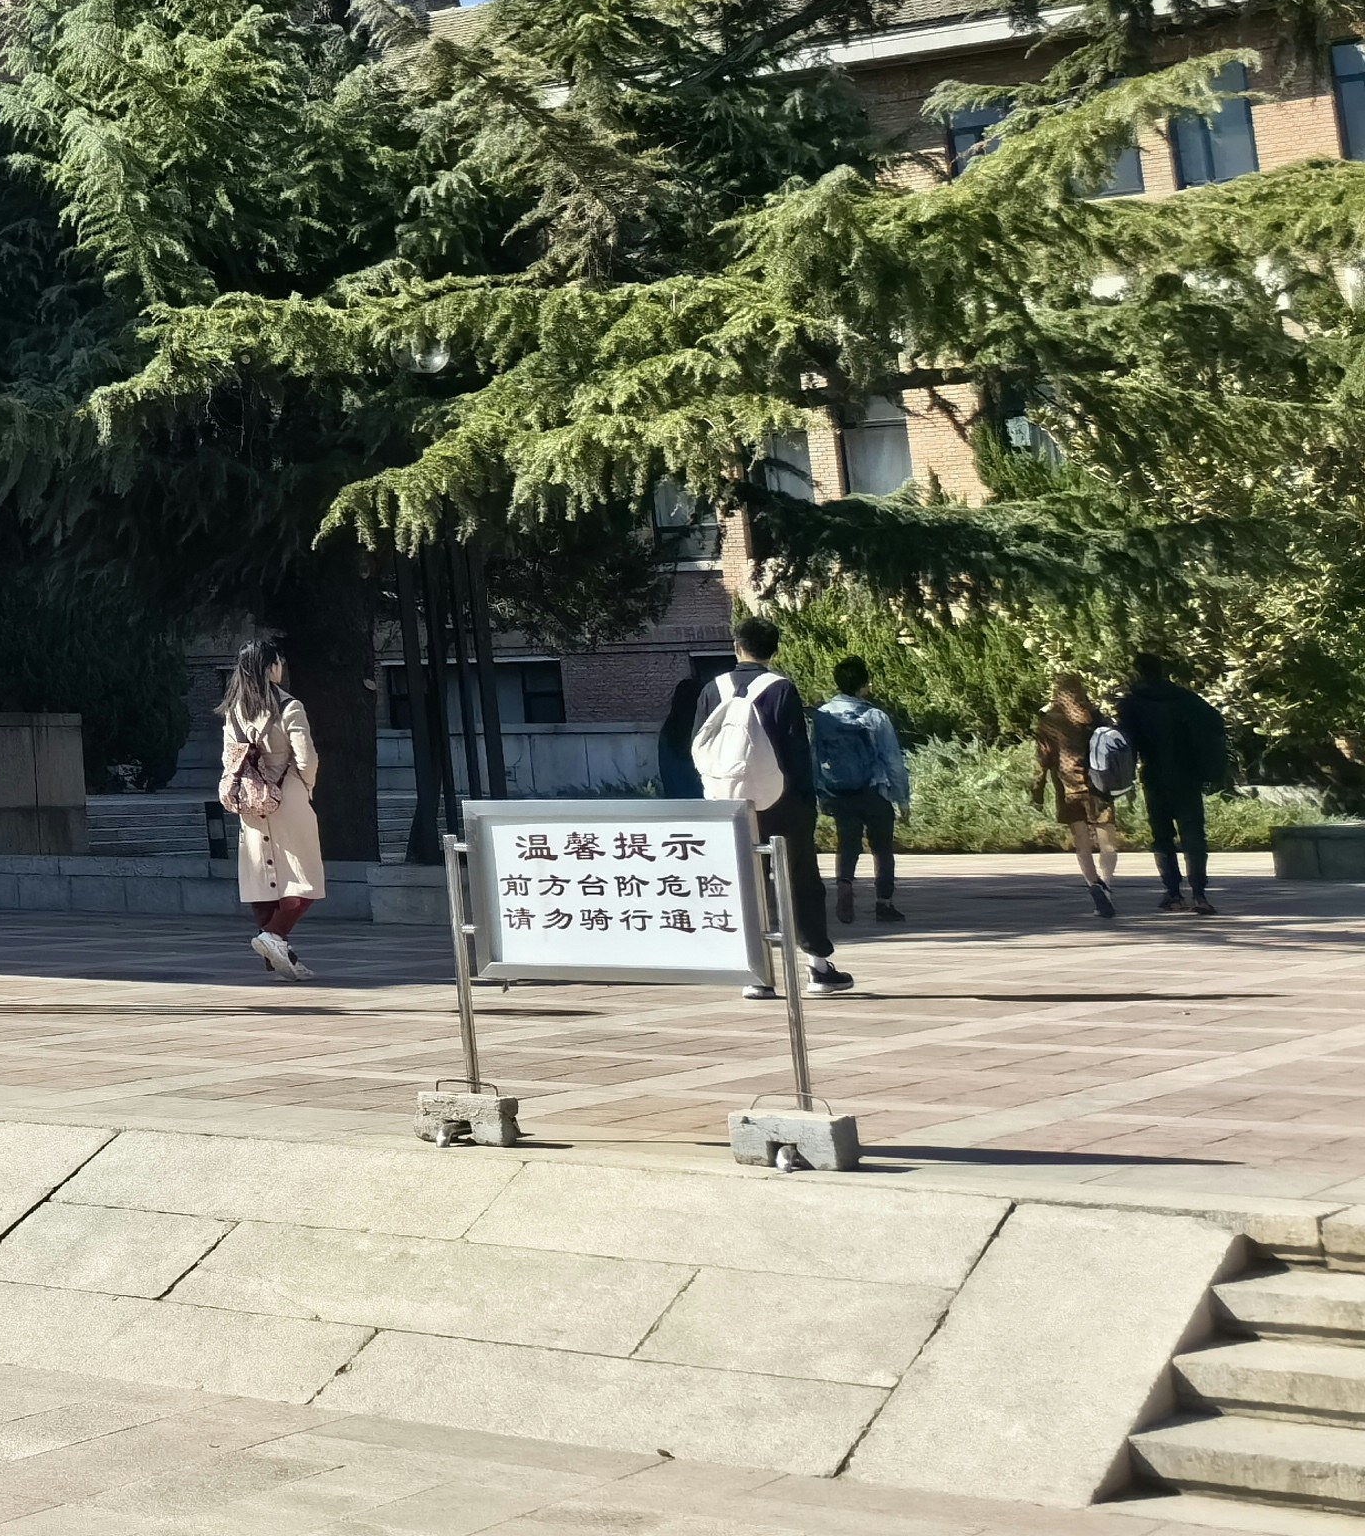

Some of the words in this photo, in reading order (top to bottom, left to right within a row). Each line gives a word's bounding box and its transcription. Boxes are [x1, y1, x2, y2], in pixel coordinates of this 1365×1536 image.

[515, 831, 706, 862] 温馨提示
[499, 873, 732, 898] 前方台阶危险
[503, 907, 738, 934] 请勿骑行通过
